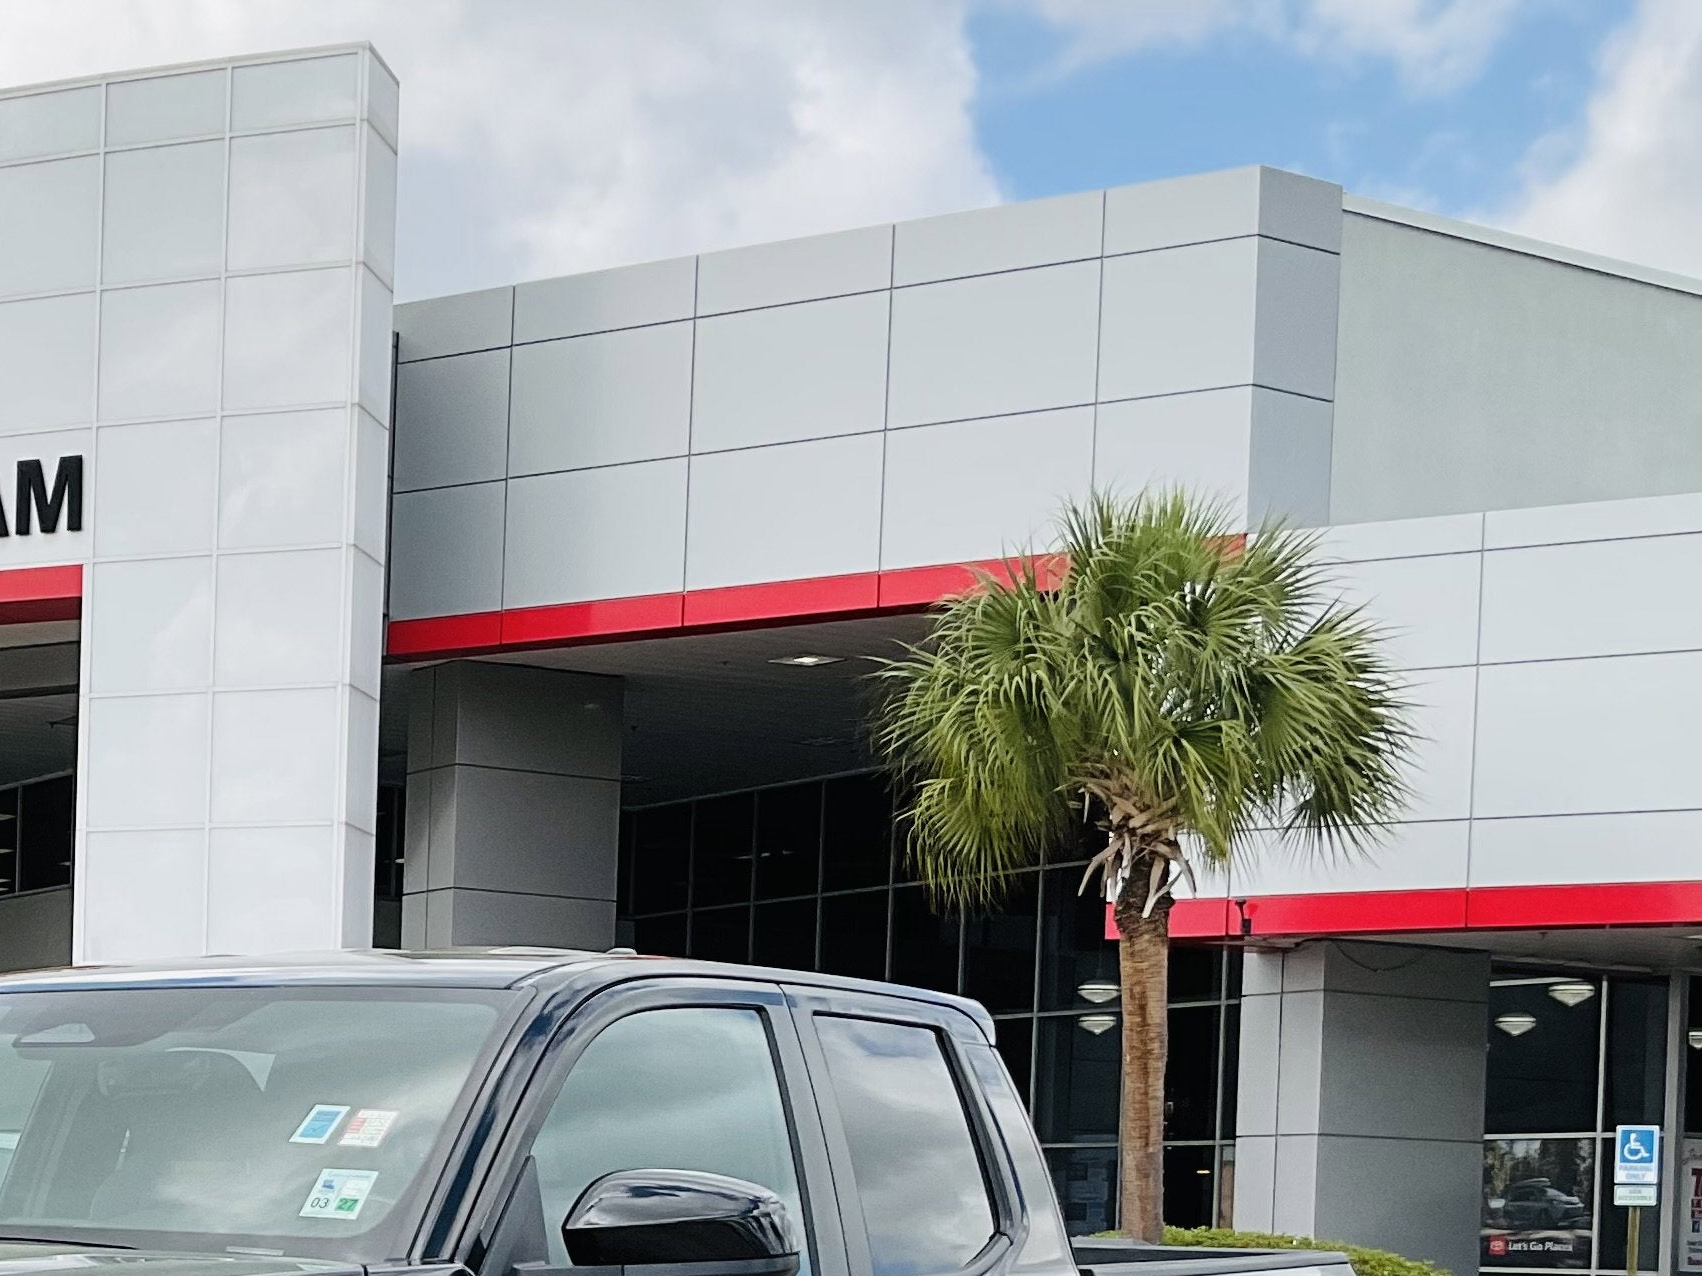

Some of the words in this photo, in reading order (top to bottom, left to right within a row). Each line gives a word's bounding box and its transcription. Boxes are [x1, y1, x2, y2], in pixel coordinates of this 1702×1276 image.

[310, 1197, 330, 1209] 03
[338, 1198, 359, 1210] 27
[1509, 1241, 1528, 1251] Let's
[1530, 1241, 1543, 1251] Go
